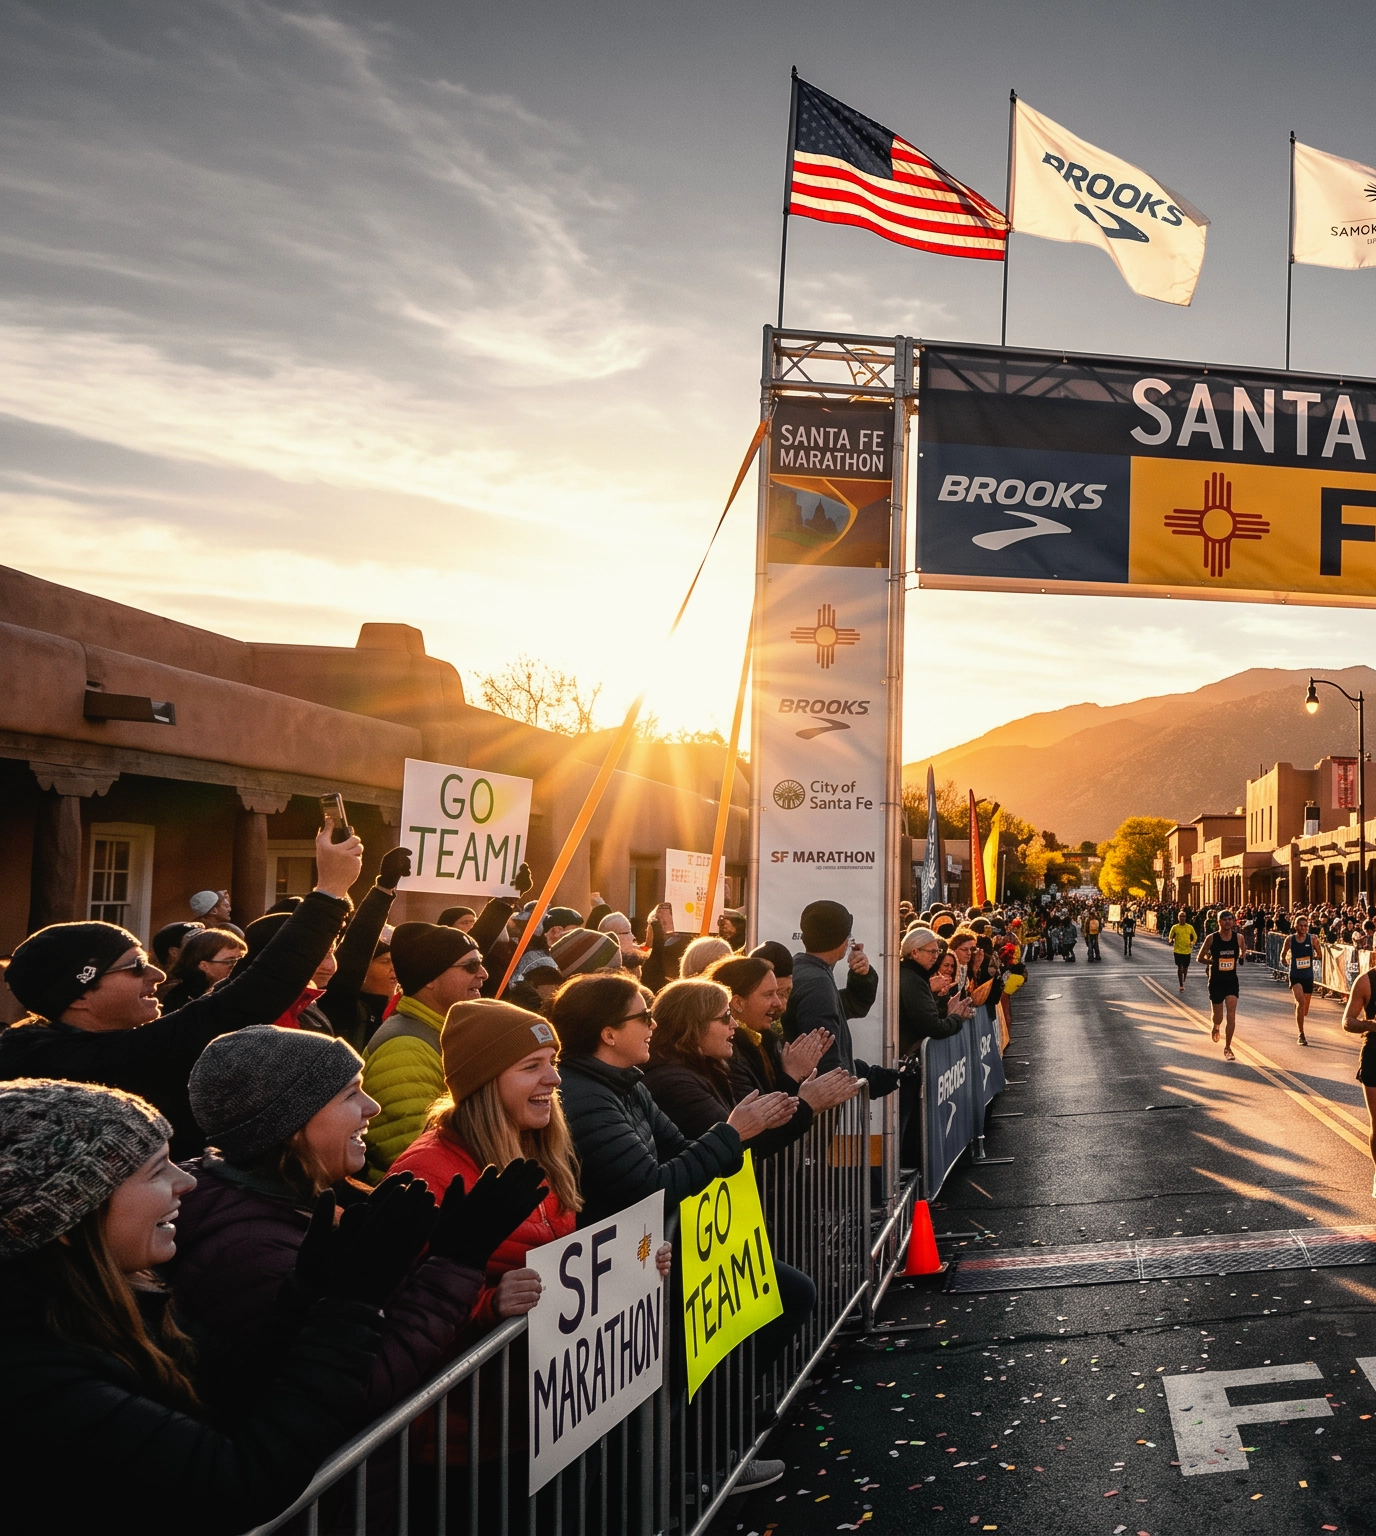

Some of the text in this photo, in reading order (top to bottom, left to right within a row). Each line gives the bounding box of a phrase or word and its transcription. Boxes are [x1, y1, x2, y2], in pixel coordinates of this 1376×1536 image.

[1042, 152, 1185, 227] BROOKS
[780, 424, 884, 451] SANTA FE
[1130, 378, 1366, 460] SANTA
[780, 448, 884, 473] MARATHON
[937, 475, 1108, 510] BROOKS
[778, 698, 870, 715] BROOKS
[440, 773, 494, 824] GO
[810, 780, 856, 796] City of
[810, 796, 873, 810] Santa Fe
[409, 825, 521, 886] TEAM!
[770, 850, 875, 863] SF MARATHON
[696, 1180, 732, 1262] GO
[558, 1224, 617, 1335] SF
[685, 1226, 770, 1359] TEAM!
[533, 1287, 661, 1459] MARATHON
